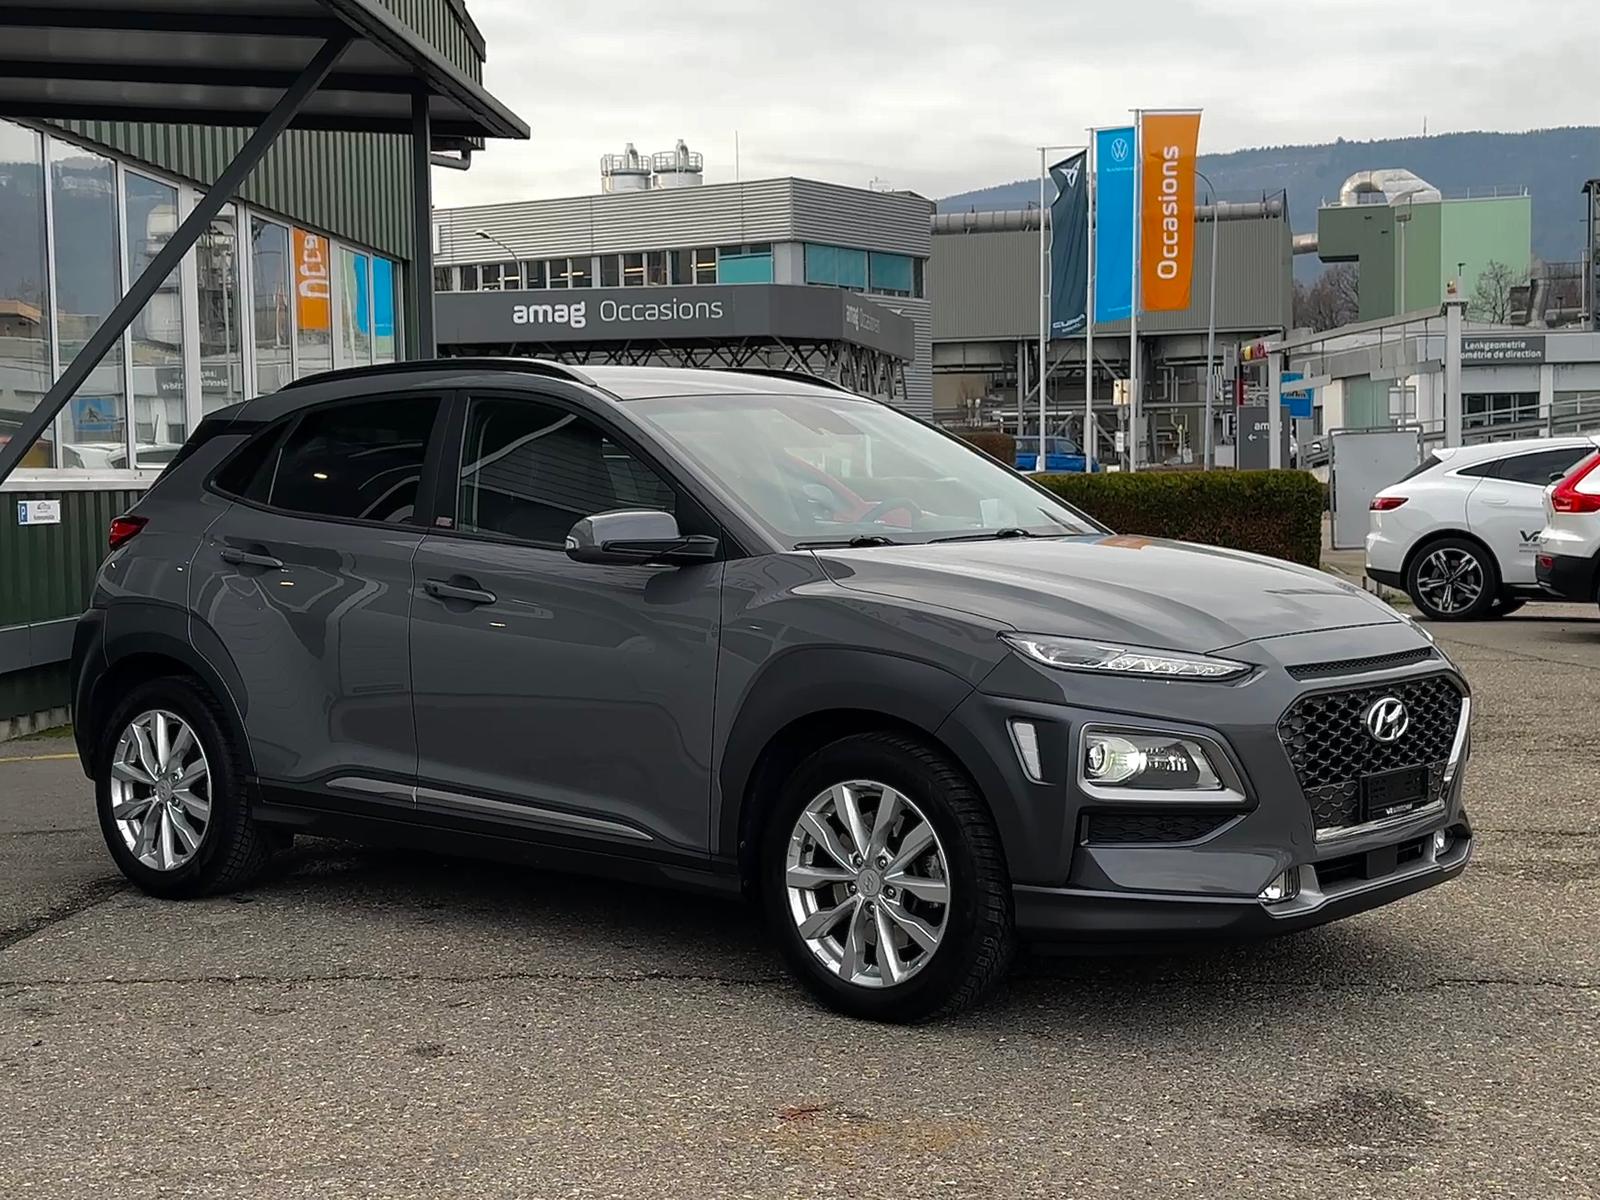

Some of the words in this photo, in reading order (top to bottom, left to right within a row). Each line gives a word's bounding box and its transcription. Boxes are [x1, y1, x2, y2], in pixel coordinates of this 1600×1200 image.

[1157, 145, 1179, 280] Occasions
[513, 301, 587, 329] amag
[600, 298, 724, 321] Occasions
[1460, 350, 1492, 360] ométrie
[1505, 349, 1541, 358] direction
[1464, 340, 1526, 351] Lenkgeometrie
